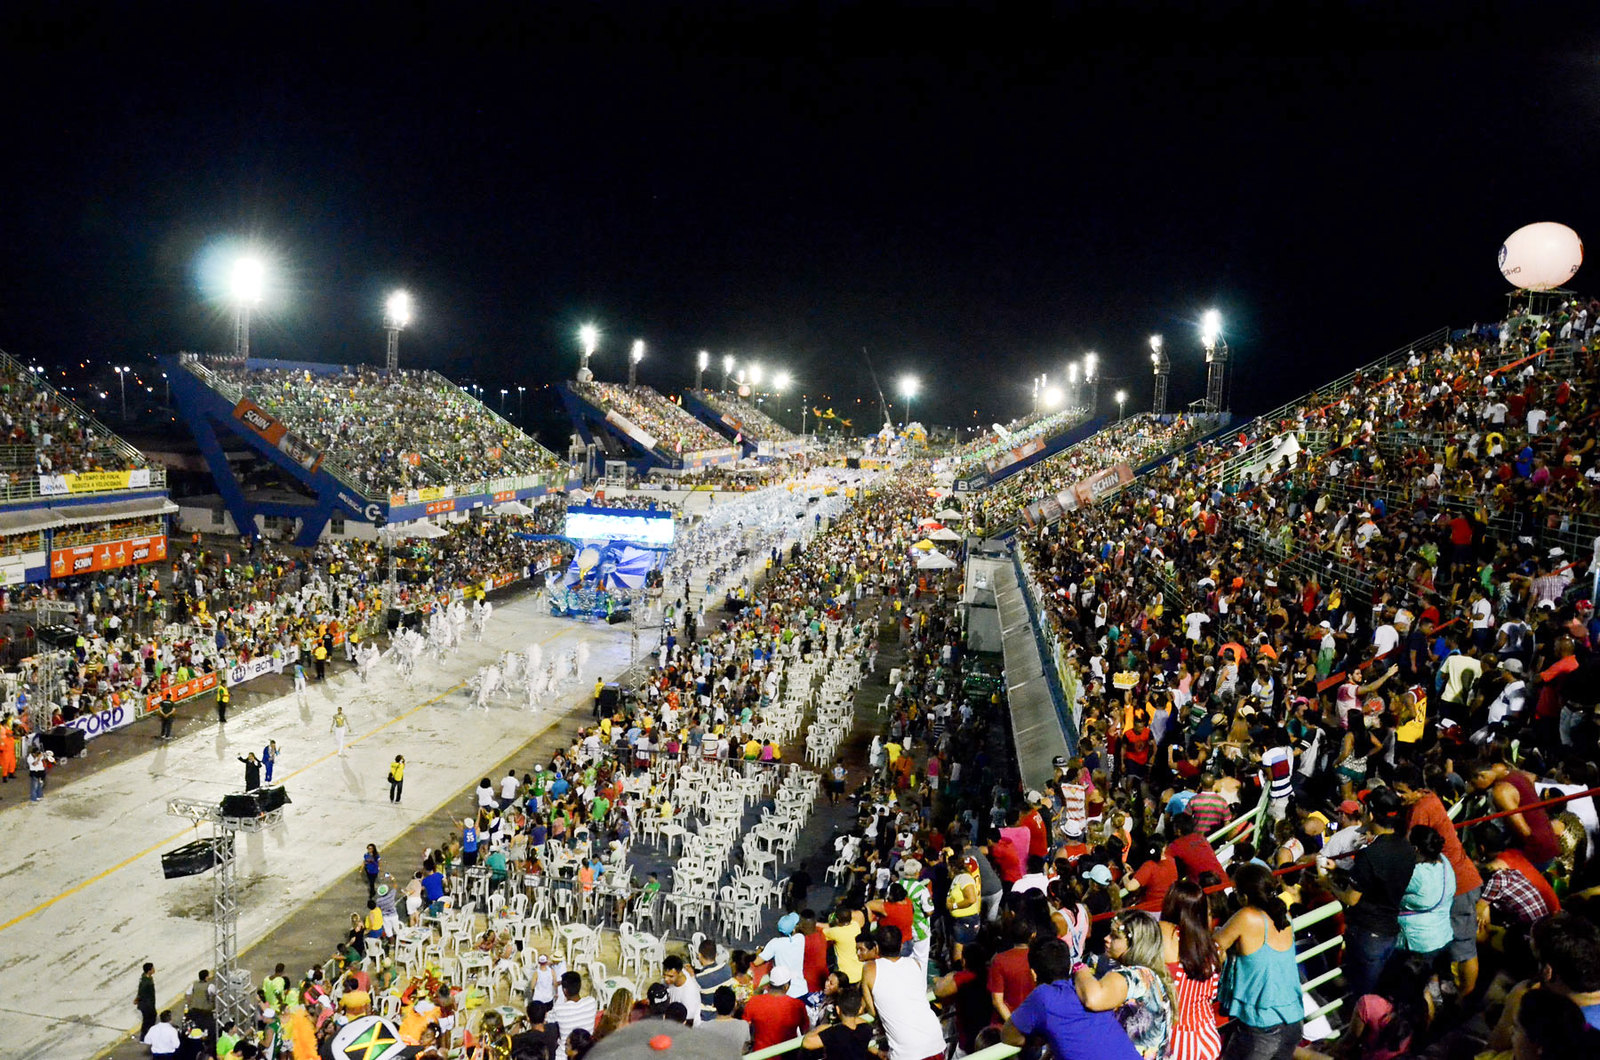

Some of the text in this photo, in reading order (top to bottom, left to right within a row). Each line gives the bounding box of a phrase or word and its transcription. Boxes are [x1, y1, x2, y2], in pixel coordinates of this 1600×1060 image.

[244, 410, 269, 430] SCHIN
[958, 481, 969, 491] B
[1091, 471, 1119, 495] SCHIN
[365, 503, 382, 521] G
[133, 548, 149, 560] SCHIN
[74, 557, 93, 570] SCHIN
